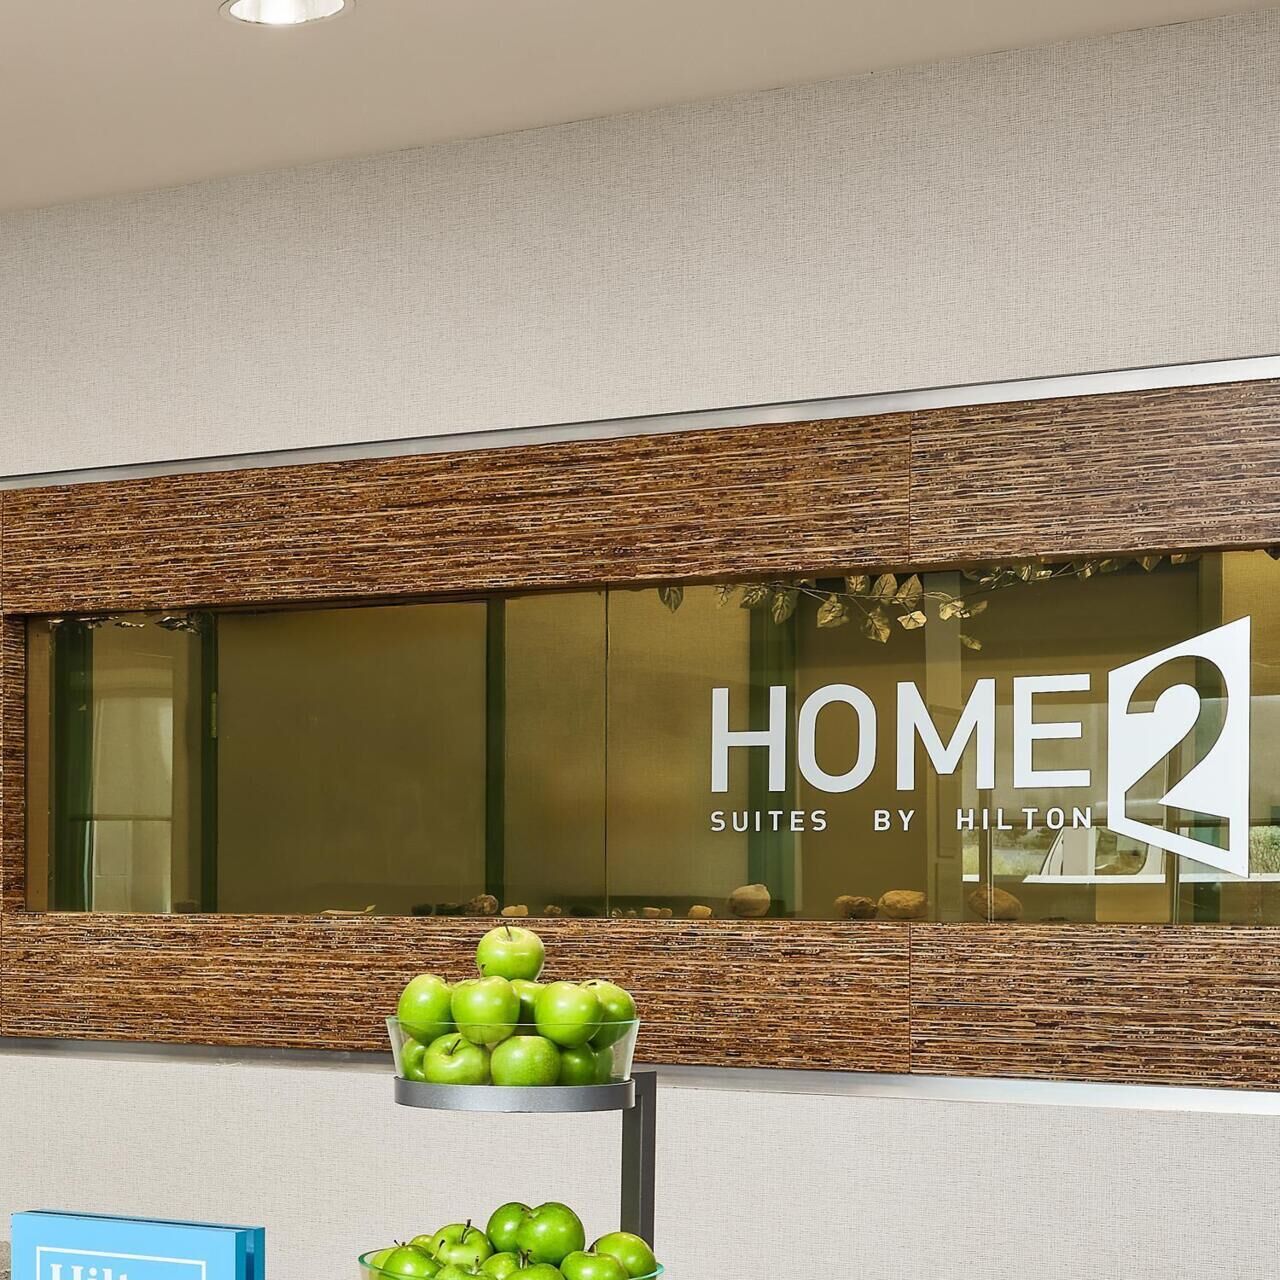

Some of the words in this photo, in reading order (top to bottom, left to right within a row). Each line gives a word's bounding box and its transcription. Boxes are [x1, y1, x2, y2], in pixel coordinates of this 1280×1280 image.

[710, 673, 1092, 794] HOME
[710, 809, 828, 833] SUITES
[873, 809, 917, 832] BY
[955, 806, 1093, 832] HILTON
